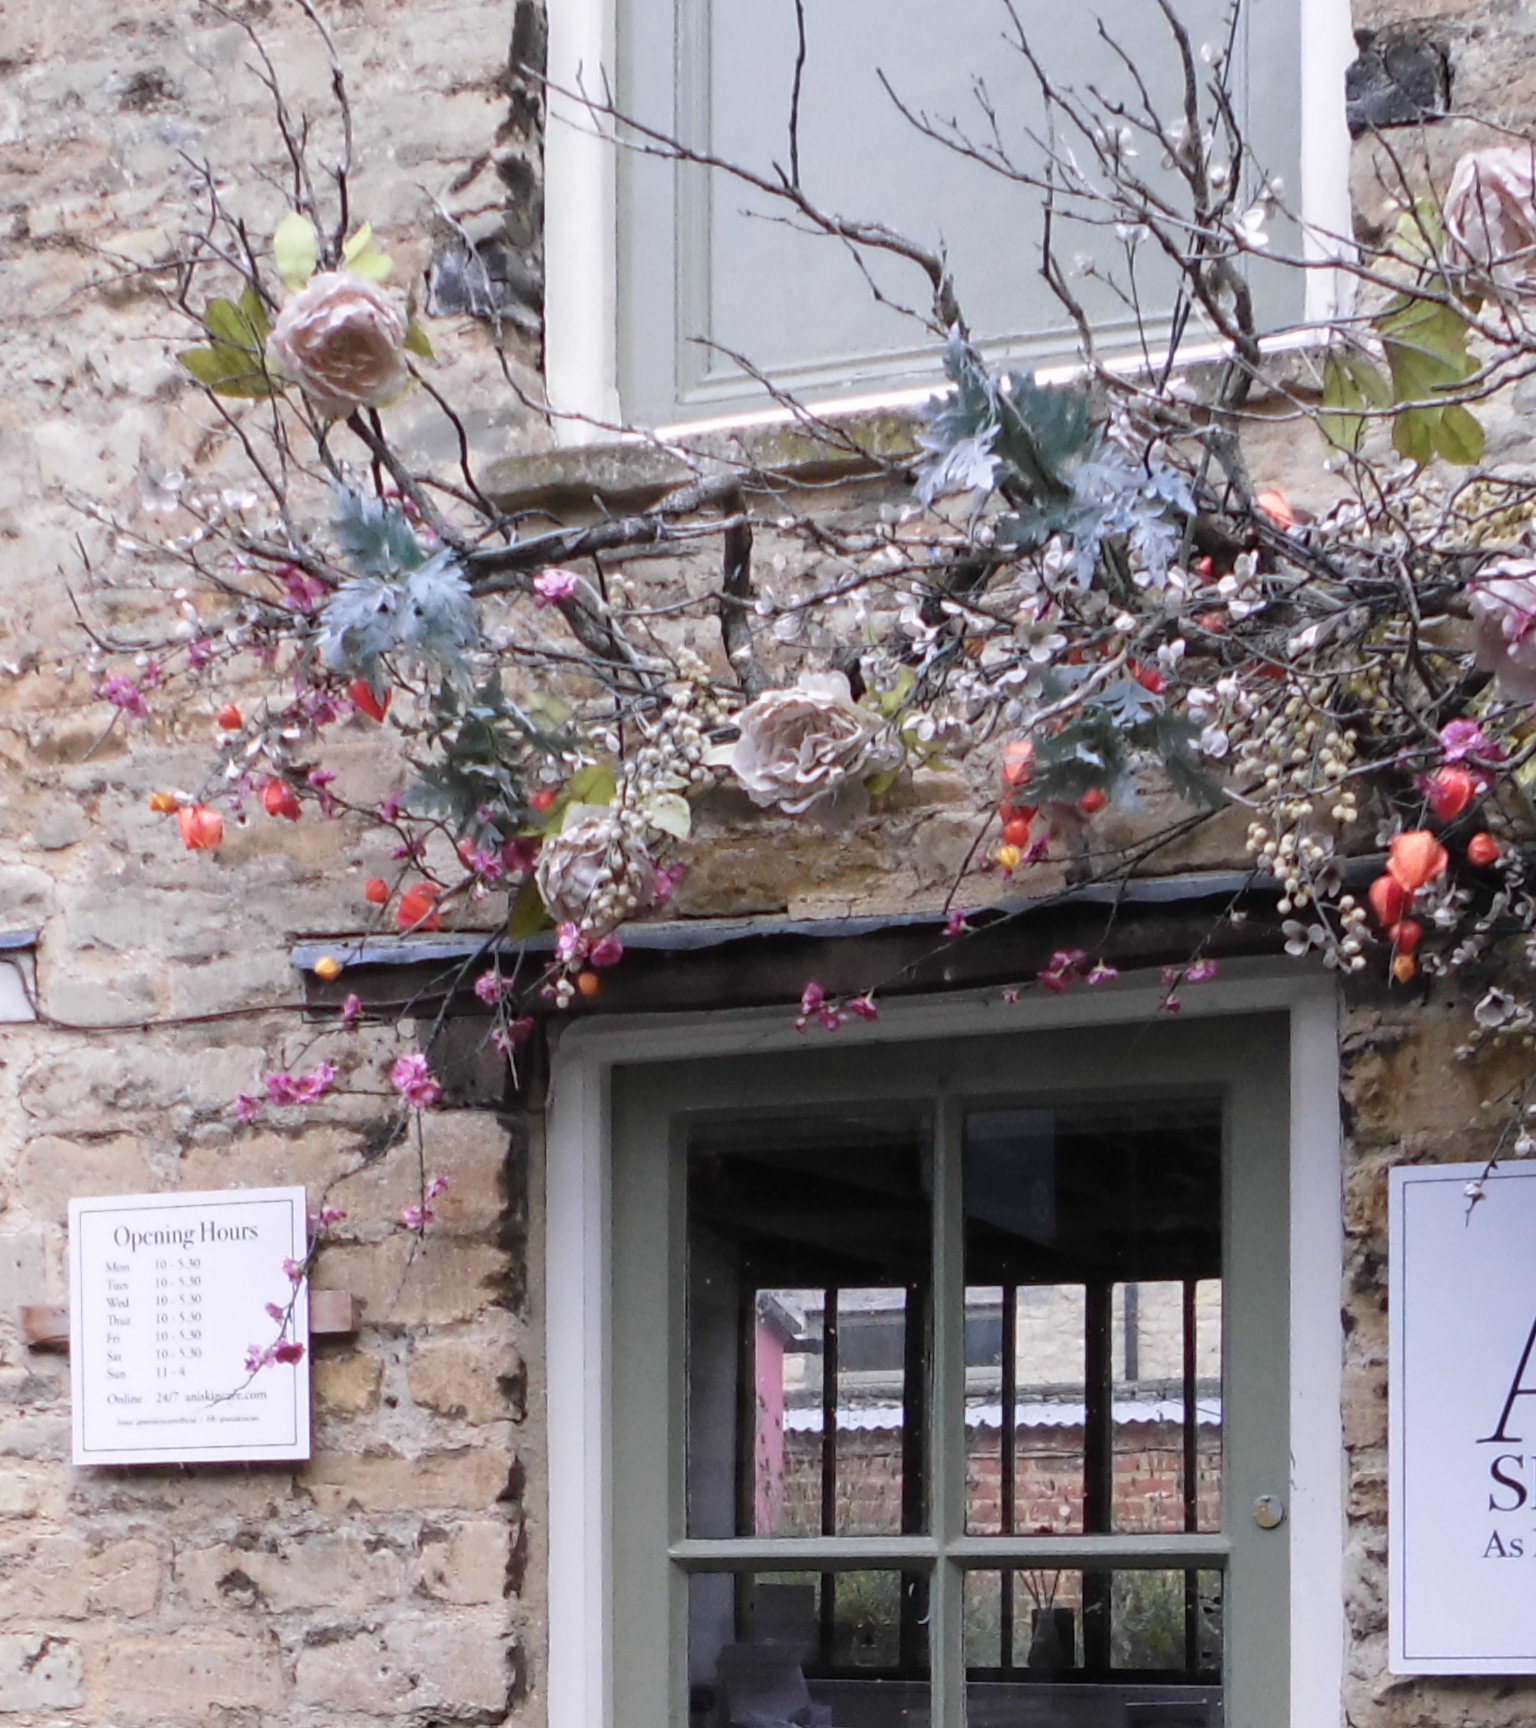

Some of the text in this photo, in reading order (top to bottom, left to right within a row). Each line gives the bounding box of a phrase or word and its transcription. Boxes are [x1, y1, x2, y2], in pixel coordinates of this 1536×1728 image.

[113, 1220, 259, 1253] Opening Hours
[105, 1261, 130, 1273] Mon
[155, 1259, 168, 1271] 10
[178, 1258, 203, 1270] 5.30
[106, 1279, 129, 1291] Tues
[155, 1276, 168, 1288] 10
[178, 1275, 203, 1287] 5.30
[106, 1296, 130, 1308] Wed
[155, 1294, 168, 1306] 10
[178, 1293, 203, 1305] 5.30
[155, 1312, 168, 1324] 10
[178, 1311, 203, 1323] 5.30
[106, 1332, 121, 1344] Fri
[155, 1330, 168, 1343] 10
[178, 1329, 203, 1342] 5.30
[106, 1351, 122, 1362] Sat
[155, 1348, 168, 1360] 10
[178, 1347, 203, 1359] 5.30
[106, 1368, 127, 1380] Sun
[156, 1366, 168, 1378] 11
[178, 1366, 187, 1377] 4
[106, 1392, 143, 1405] Online
[156, 1389, 180, 1404] 24/7
[1482, 1529, 1525, 1559] As
